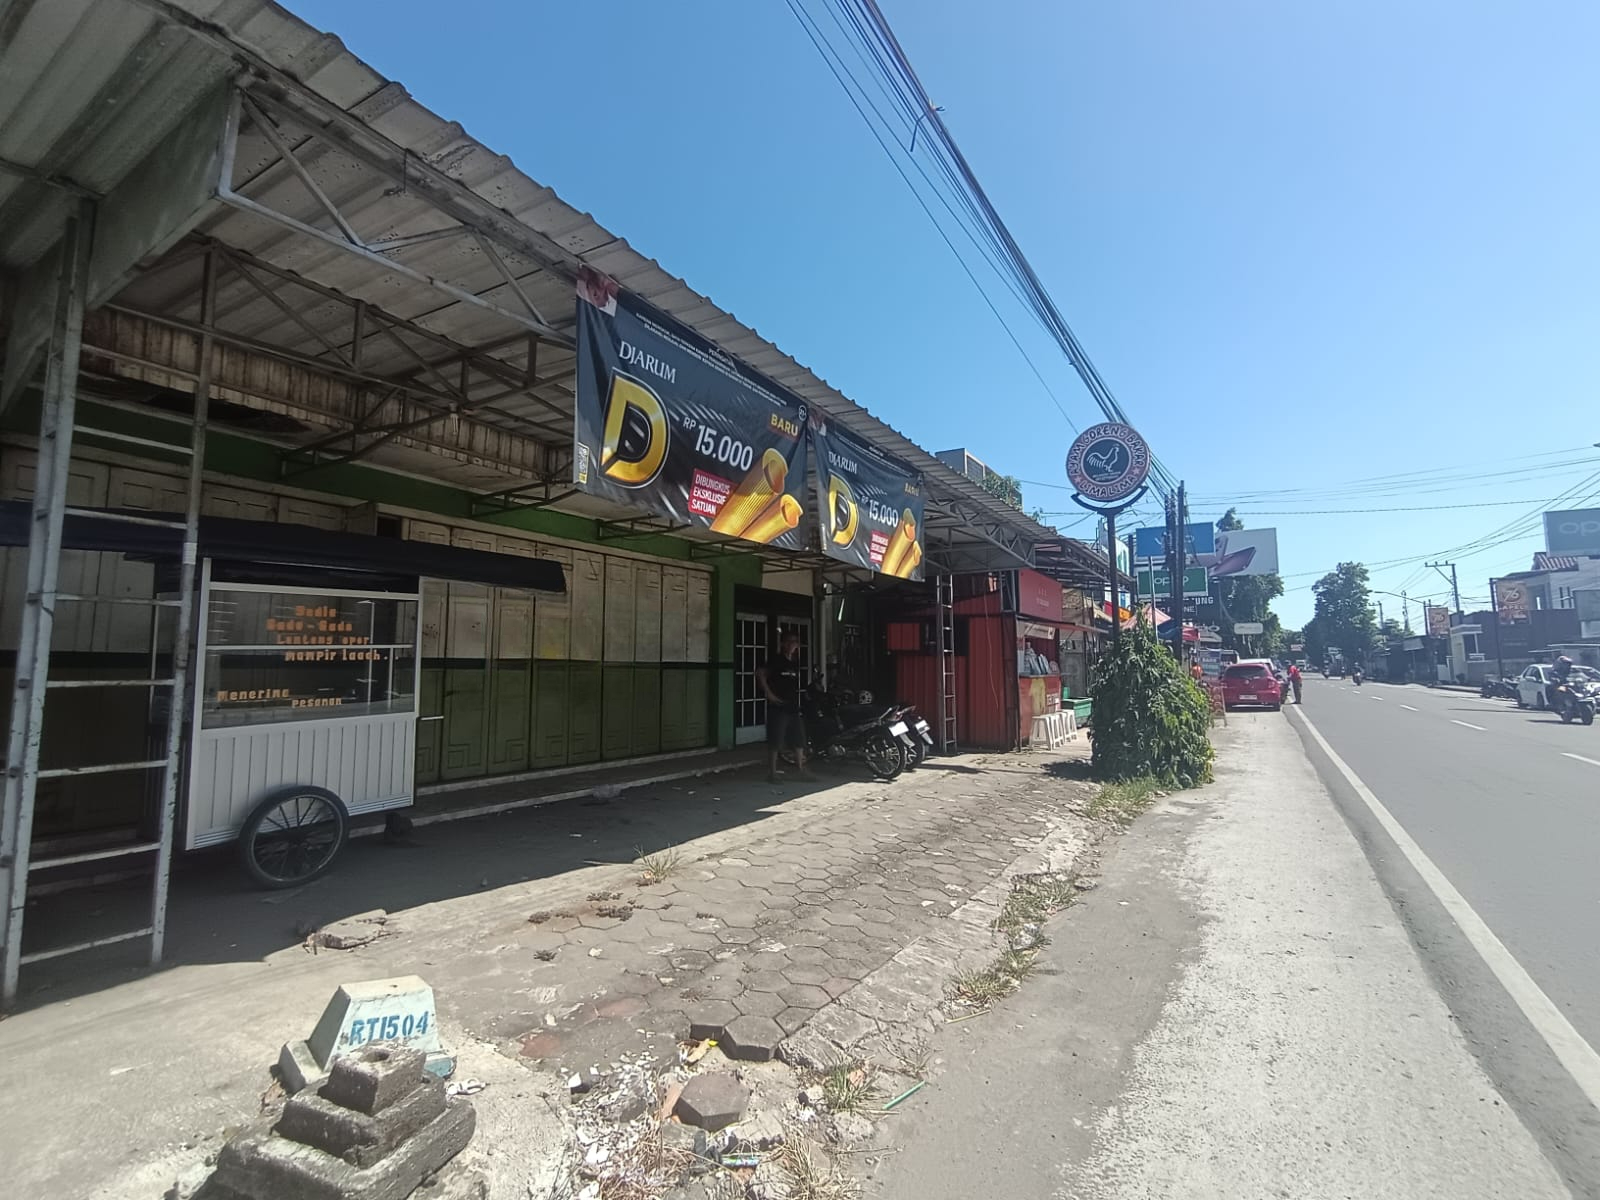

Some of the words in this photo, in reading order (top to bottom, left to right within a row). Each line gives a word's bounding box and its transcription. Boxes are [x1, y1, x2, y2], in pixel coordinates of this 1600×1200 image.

[618, 340, 677, 384] DJARUM
[600, 369, 670, 487] D
[770, 413, 799, 437] BARU
[683, 416, 696, 431] RP
[695, 424, 754, 472] 15.000
[1068, 442, 1086, 476] AYAM
[1082, 424, 1129, 445] GORENG
[1125, 433, 1146, 468] BAKAR
[828, 451, 858, 475] DJARUM
[1079, 478, 1108, 497] LIMA
[1107, 474, 1138, 496] LIMA
[691, 498, 717, 515] SATUAN
[828, 471, 859, 548] D
[868, 499, 899, 528] 15.000
[1503, 587, 1521, 602] 76
